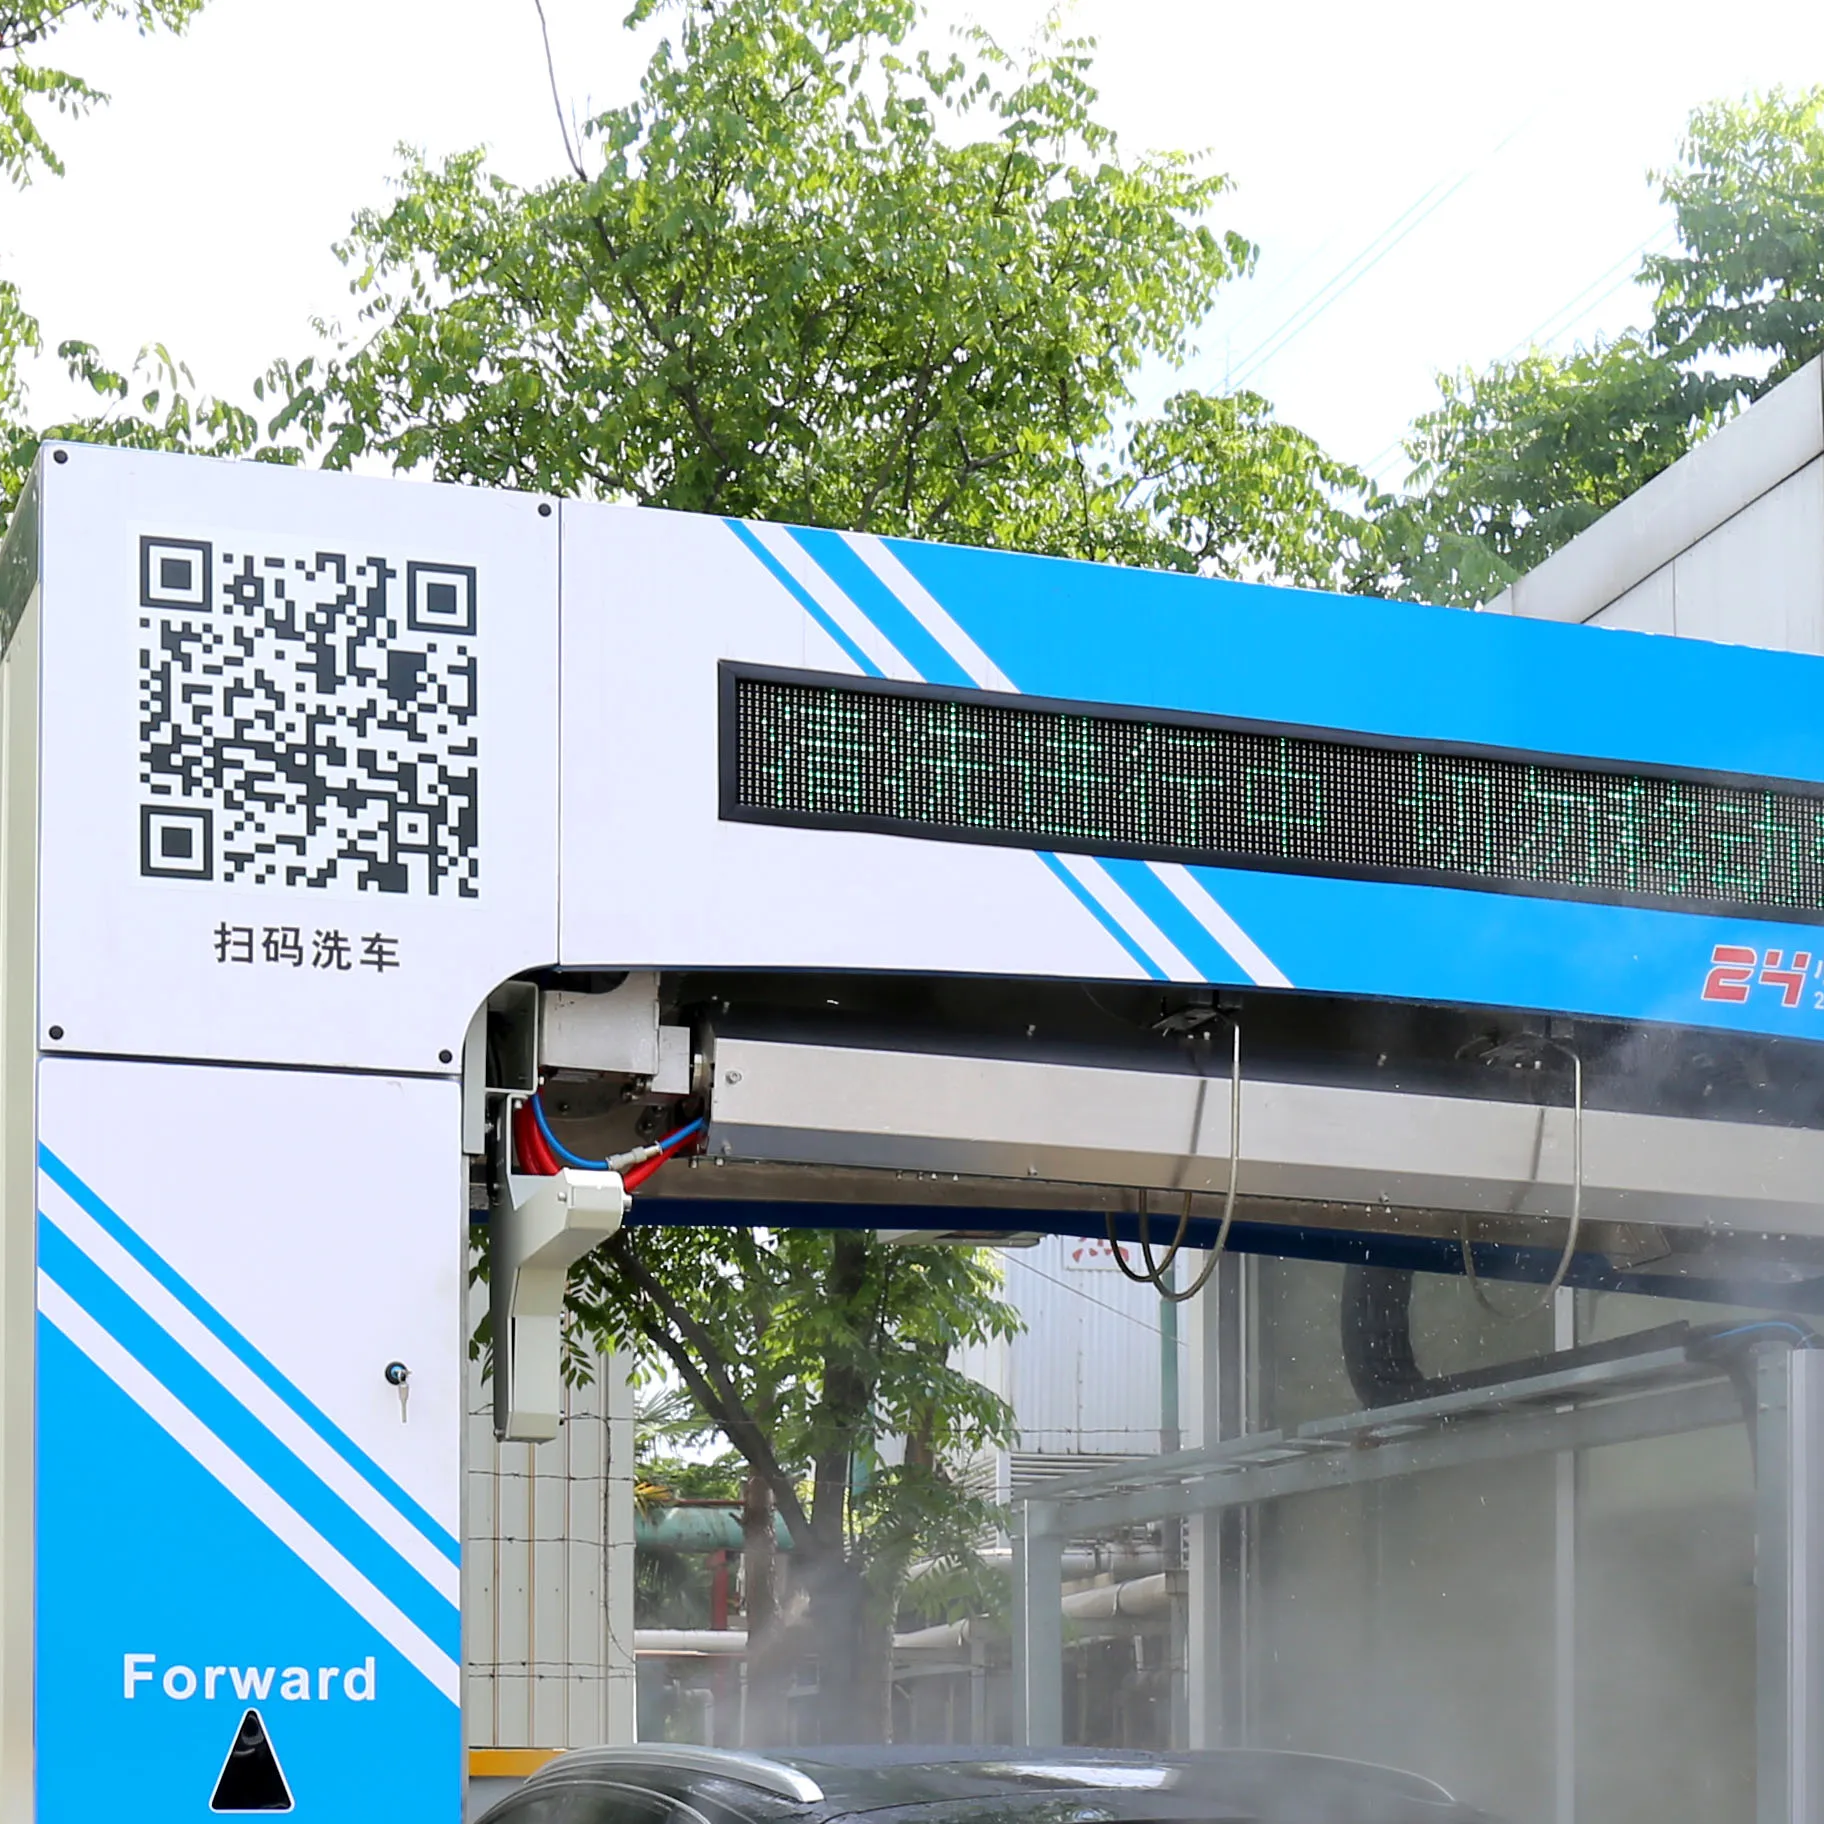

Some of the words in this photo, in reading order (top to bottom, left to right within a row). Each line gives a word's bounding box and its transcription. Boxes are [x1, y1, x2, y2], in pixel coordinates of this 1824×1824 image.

[213, 921, 401, 972] 扫码洗车
[122, 1653, 377, 1702] Forward
